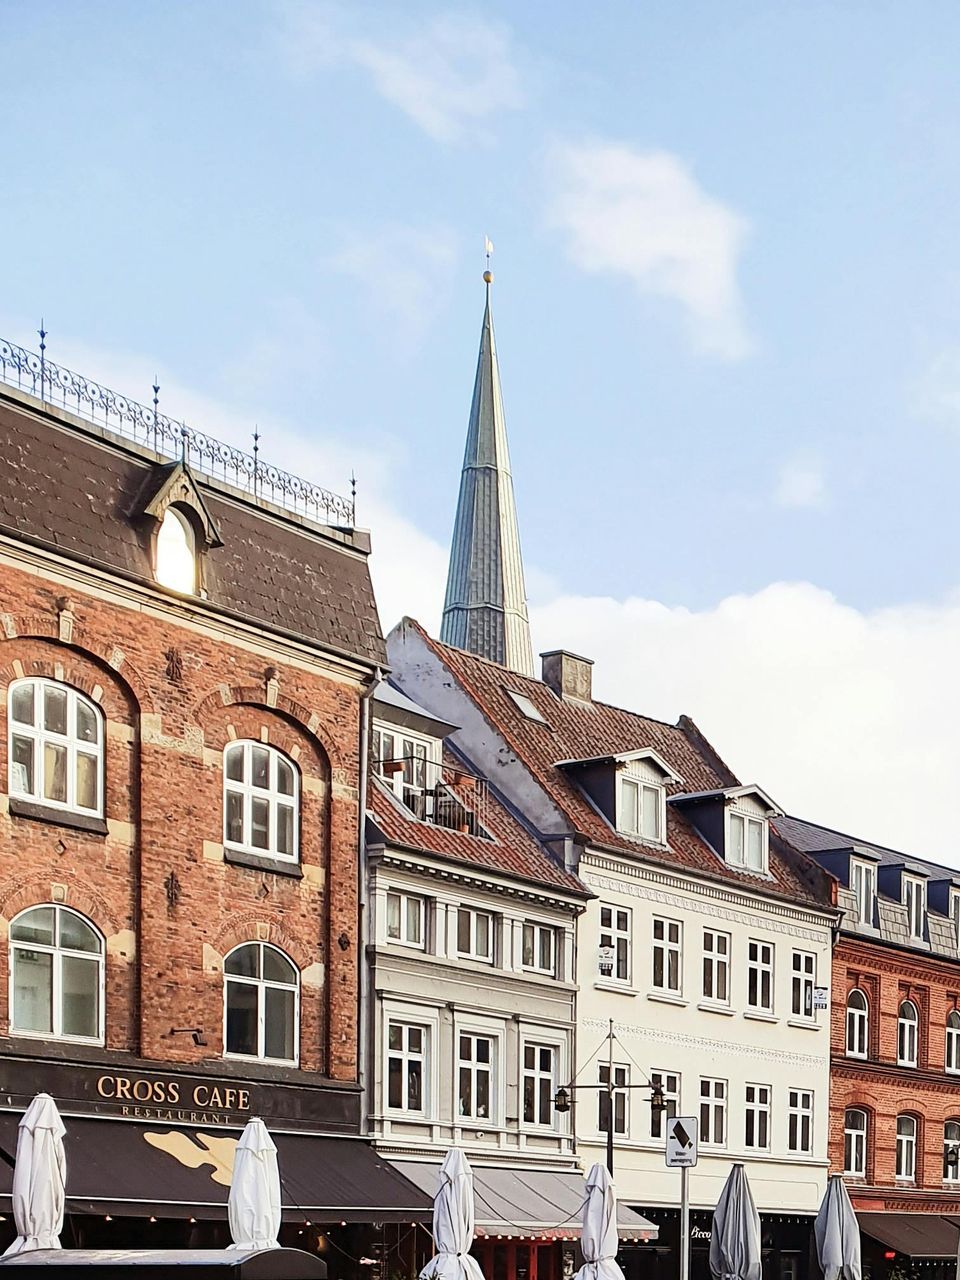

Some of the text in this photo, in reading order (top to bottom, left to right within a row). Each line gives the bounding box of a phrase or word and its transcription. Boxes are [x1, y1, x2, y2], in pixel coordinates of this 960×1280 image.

[97, 1075, 250, 1110] CROSS CAFE
[122, 1105, 231, 1124] RESTAURANT
